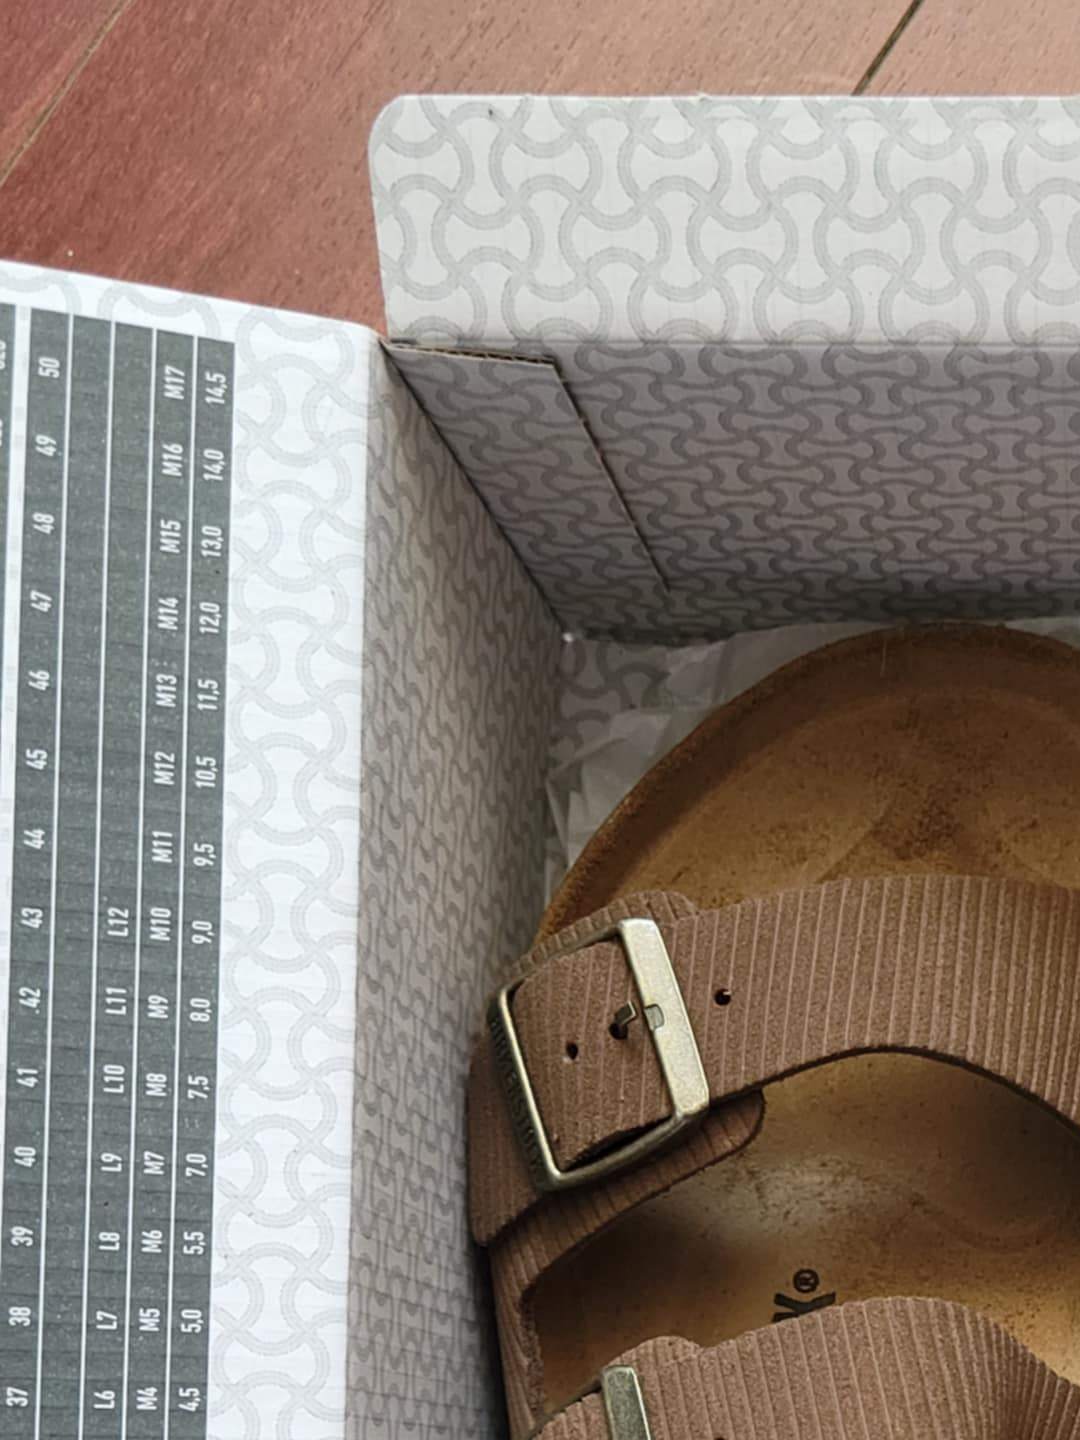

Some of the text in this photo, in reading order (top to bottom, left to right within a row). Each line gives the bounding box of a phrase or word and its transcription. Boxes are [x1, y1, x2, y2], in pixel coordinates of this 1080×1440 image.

[38, 357, 60, 378] 50
[164, 364, 185, 399] M17
[205, 371, 227, 404] 14,5
[35, 434, 56, 456] 49
[162, 443, 183, 476] M16
[203, 449, 225, 480] 14,0
[32, 512, 54, 534] 48
[160, 519, 181, 553] M15
[201, 525, 224, 557] 13,0
[30, 590, 52, 612] 47
[157, 598, 178, 630] M14
[199, 602, 222, 633] 12,0
[28, 670, 50, 690] 46
[155, 673, 177, 707] M13
[197, 679, 220, 710] 11,5
[26, 748, 48, 770] 45
[153, 751, 175, 785] M12
[194, 756, 218, 788] 10,5
[23, 828, 45, 849] 44
[152, 831, 173, 863] M11
[193, 843, 216, 866] 9,5
[20, 908, 43, 928] 43
[107, 907, 129, 937] L12
[149, 907, 171, 941] M10
[192, 920, 215, 944] 9,0
[18, 987, 41, 1007] 42
[105, 987, 127, 1015] L11
[147, 995, 169, 1018] M9
[189, 998, 212, 1022] 8,0
[16, 1068, 38, 1088] 41
[103, 1064, 125, 1093] L10
[145, 1073, 167, 1097] M8
[187, 1074, 210, 1099] 7,5
[14, 1146, 36, 1167] 40
[100, 1153, 122, 1172] L9
[143, 1151, 165, 1175] M7
[185, 1153, 208, 1176] 7,0
[10, 1226, 33, 1246] 39
[98, 1232, 120, 1251] L8
[141, 1230, 163, 1253] M6
[183, 1231, 206, 1255] 5,5
[8, 1307, 31, 1326] 38
[96, 1310, 117, 1330] L7
[138, 1308, 160, 1331] M5
[180, 1309, 204, 1333] 5,0
[6, 1387, 29, 1407] 37
[93, 1390, 115, 1409] L6
[136, 1387, 158, 1410] M4
[178, 1387, 201, 1412] 4,5
